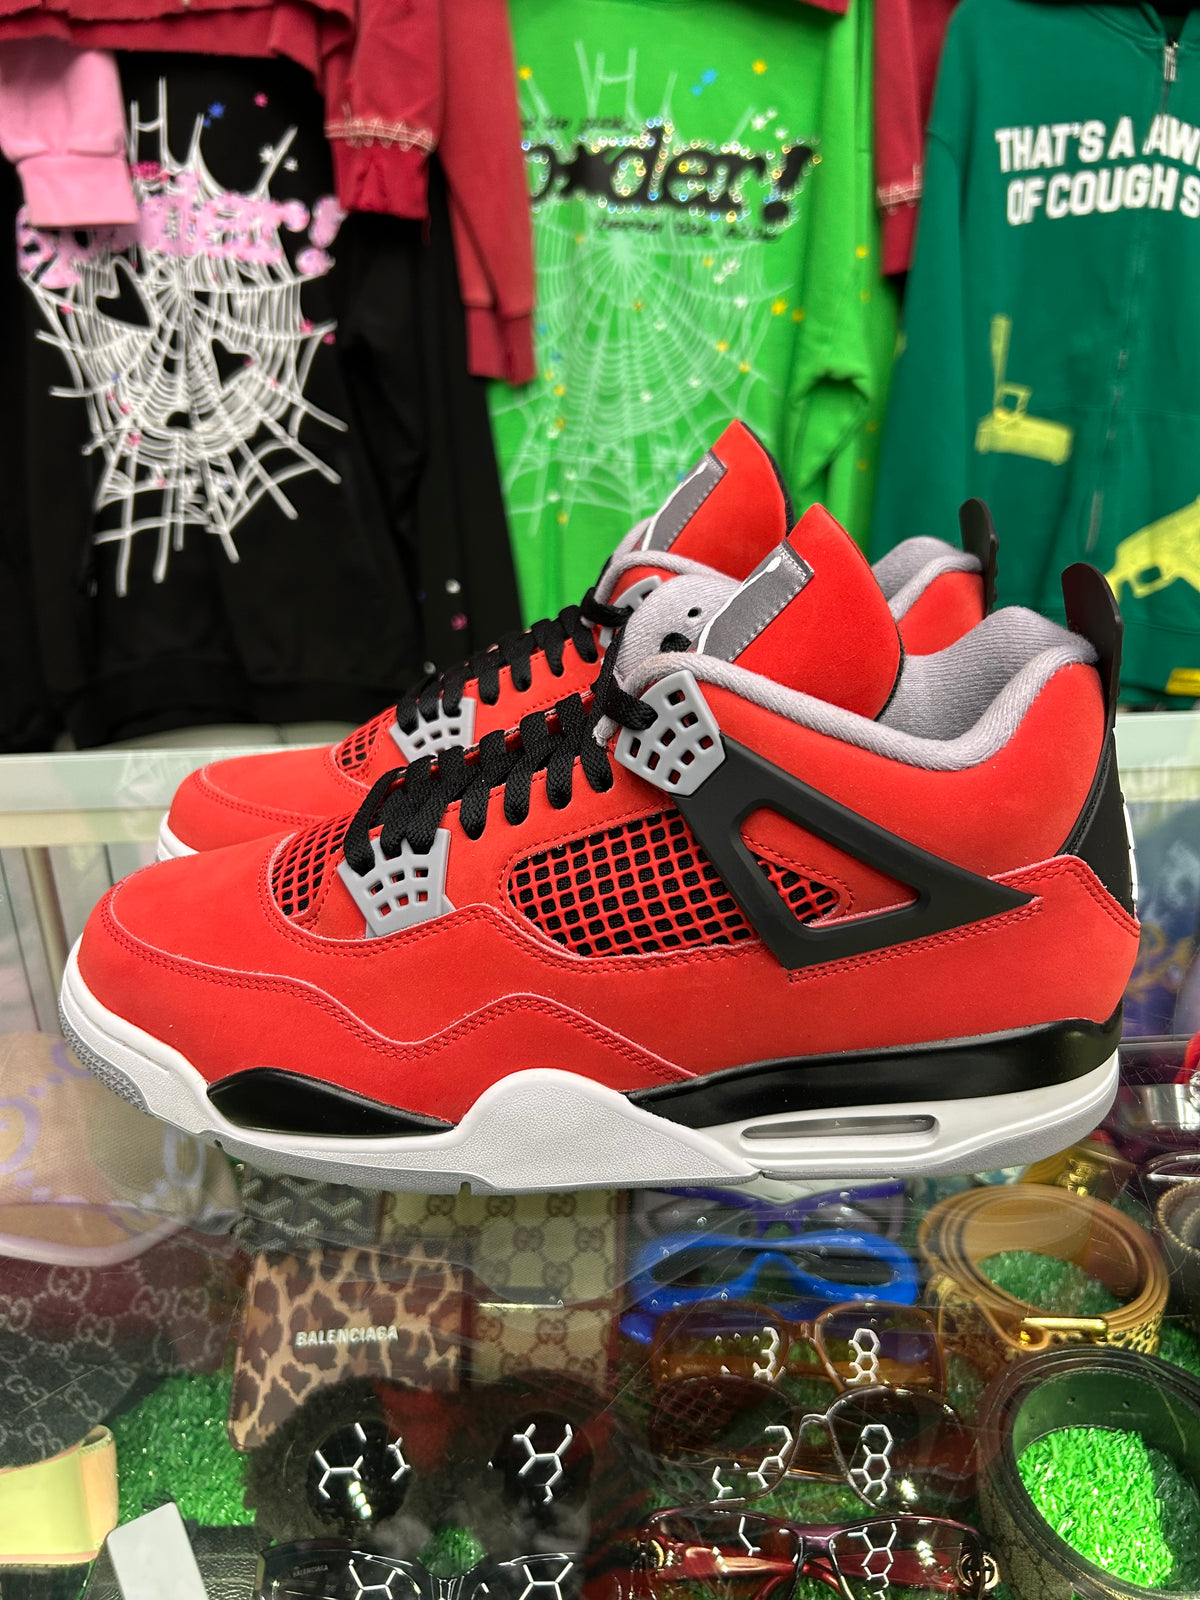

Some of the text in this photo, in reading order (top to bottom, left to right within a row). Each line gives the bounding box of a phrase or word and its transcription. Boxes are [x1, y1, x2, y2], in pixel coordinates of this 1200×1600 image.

[995, 113, 1200, 173] THAT'S A AW
[1007, 177, 1046, 226] OF
[1046, 163, 1180, 219] COUGH
[295, 1325, 398, 1346] BALENCIAGA
